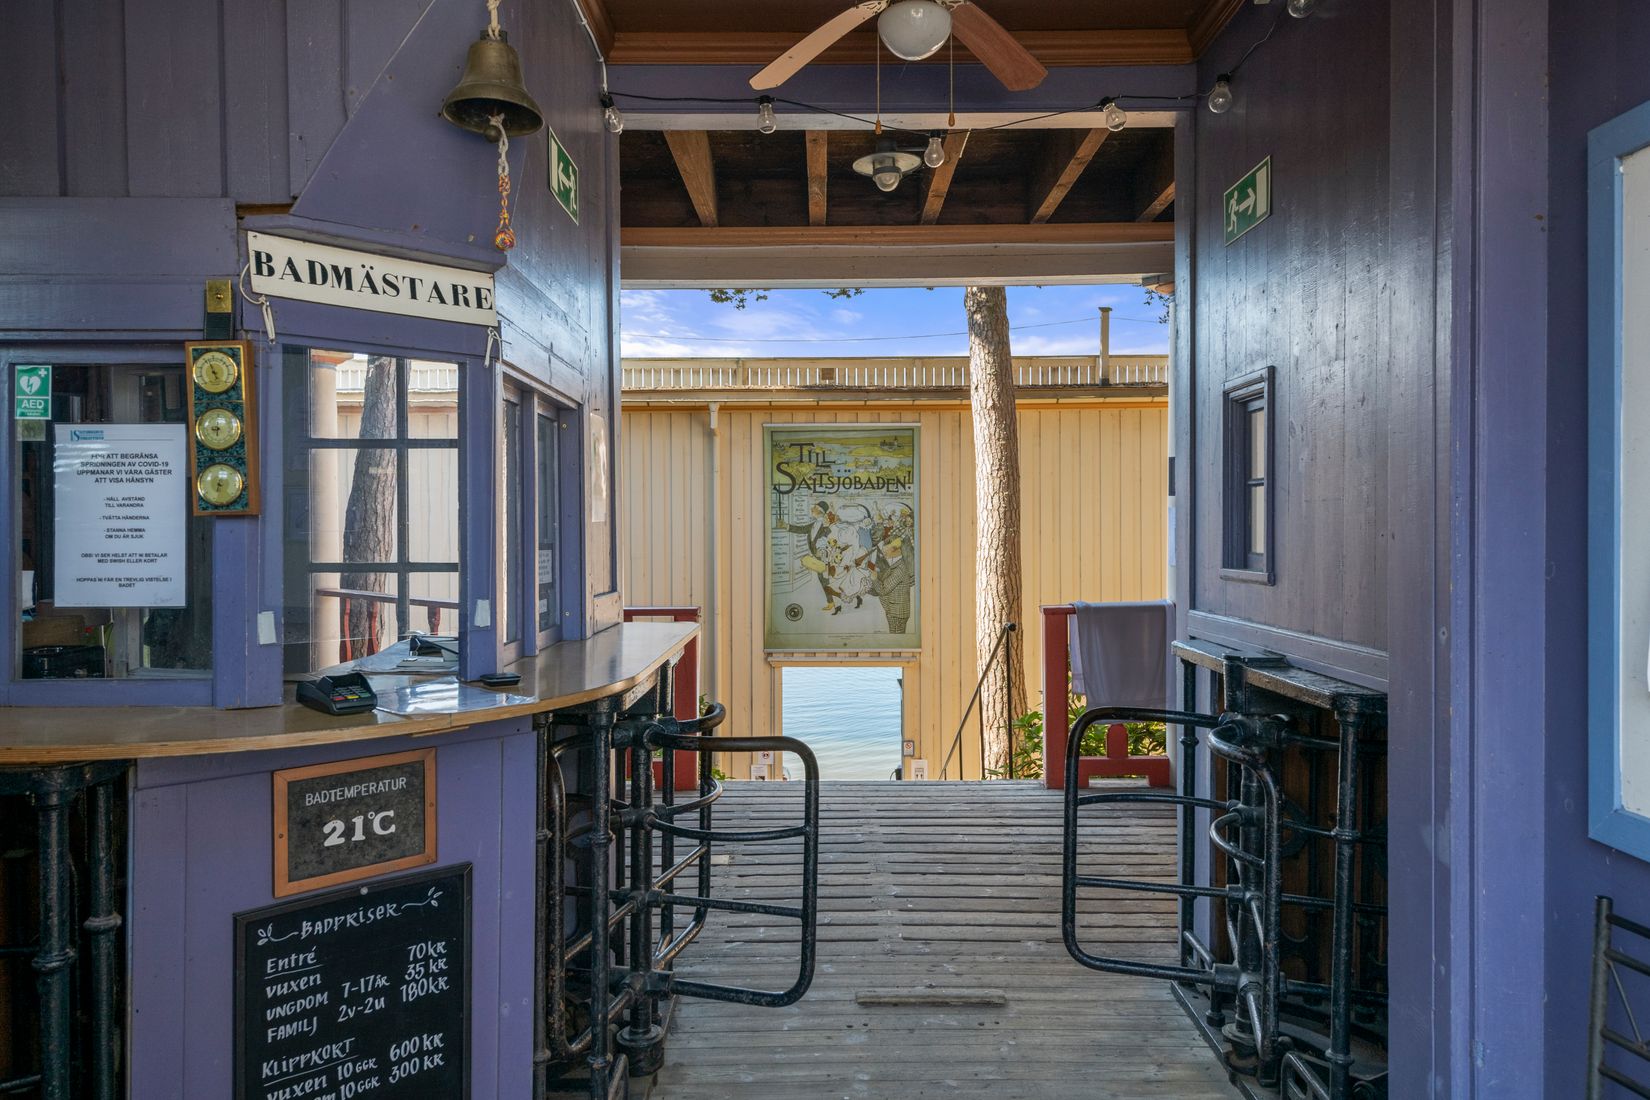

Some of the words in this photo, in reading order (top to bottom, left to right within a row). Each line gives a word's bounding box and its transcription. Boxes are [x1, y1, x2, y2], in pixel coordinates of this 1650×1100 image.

[253, 250, 493, 310] BADMÄSTARE
[21, 399, 44, 409] AED
[789, 443, 835, 468] TILL
[306, 777, 407, 806] BADTEMPERATUR
[267, 946, 317, 973] Entré
[266, 992, 328, 1021] UNGDOM
[405, 961, 425, 980] 35
[267, 1016, 317, 1043] FAMILJ
[337, 1062, 353, 1081] 10
[390, 1036, 419, 1062] 600
[339, 1081, 356, 1100] 10
[389, 1058, 419, 1084] 300
